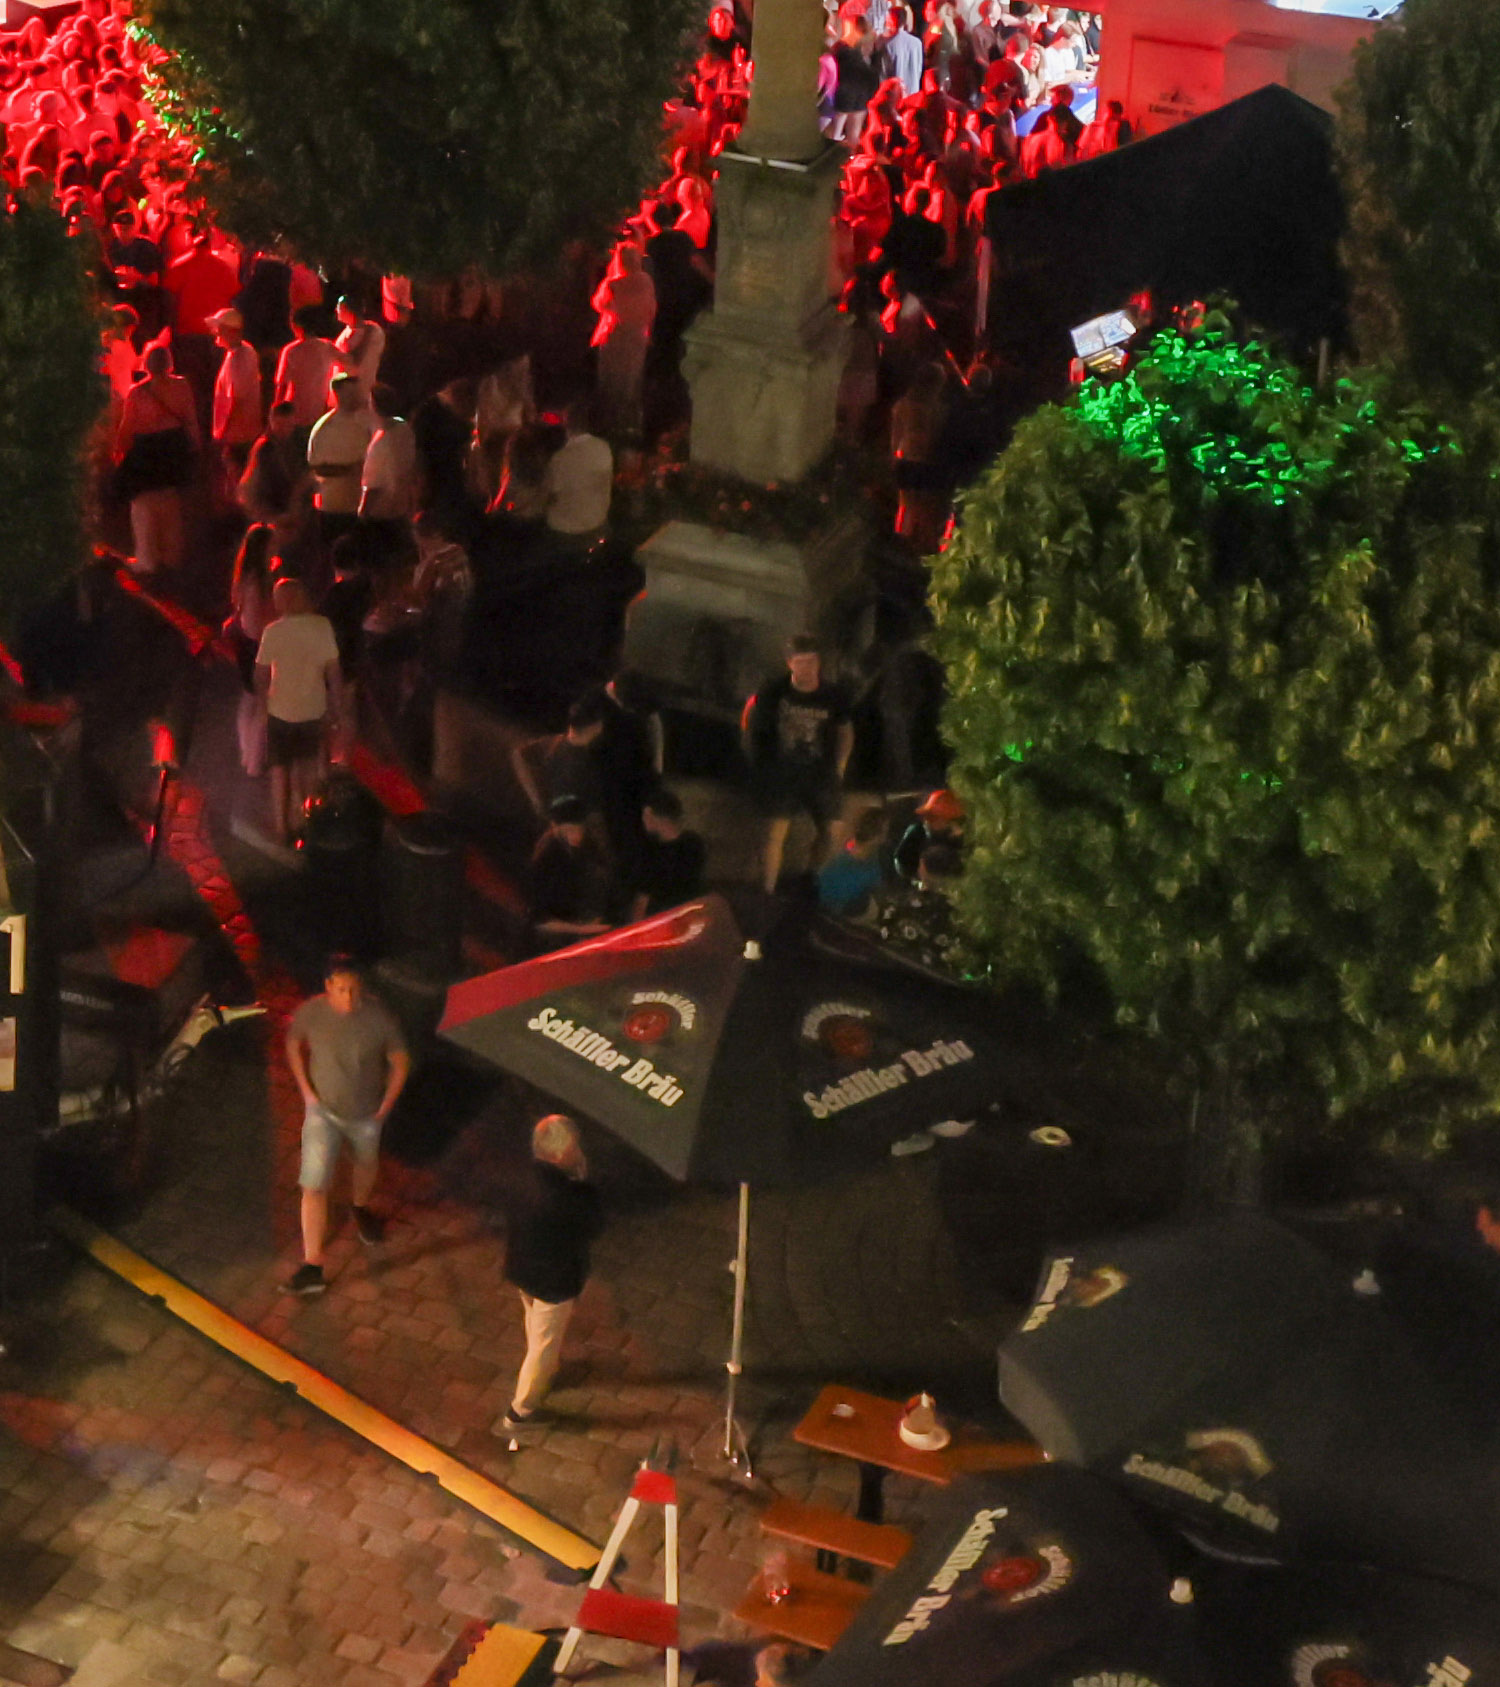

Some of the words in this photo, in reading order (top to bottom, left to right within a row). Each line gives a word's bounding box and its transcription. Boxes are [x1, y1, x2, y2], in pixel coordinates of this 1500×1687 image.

[527, 1007, 630, 1073] Schäffler
[620, 1057, 685, 1108] Bräu
[803, 1062, 909, 1119] Schäffler
[901, 1038, 975, 1078] Bräu
